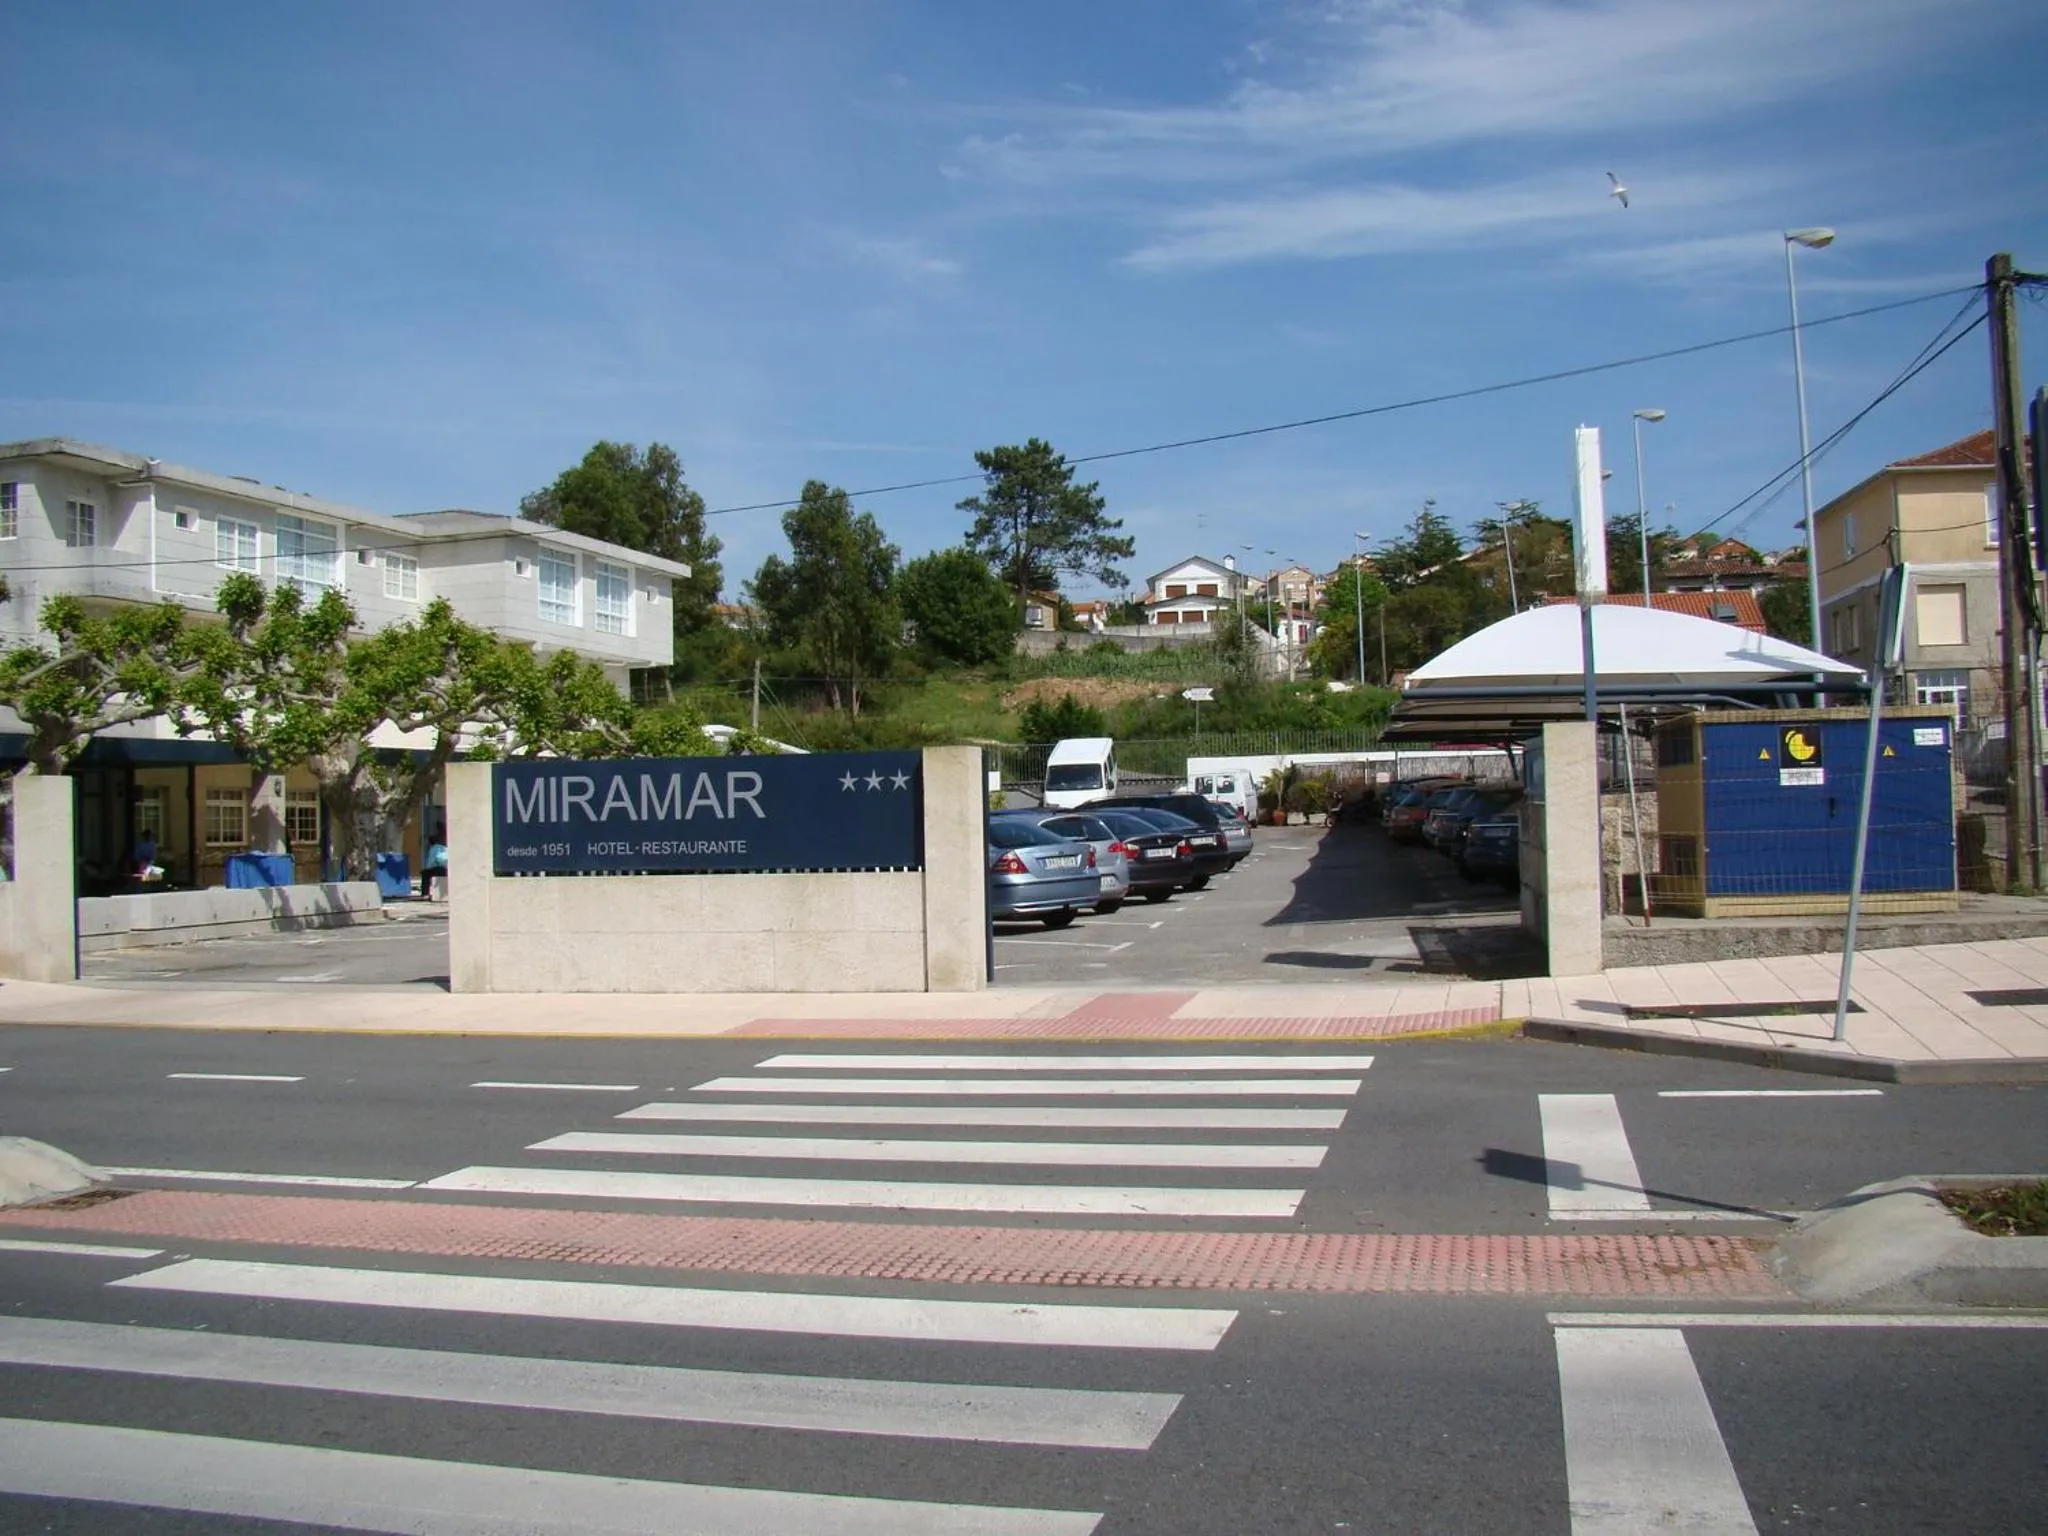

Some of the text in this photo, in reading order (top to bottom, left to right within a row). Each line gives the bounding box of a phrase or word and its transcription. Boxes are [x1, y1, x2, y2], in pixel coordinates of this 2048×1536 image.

[505, 770, 767, 824] MIRAMAR
[506, 844, 538, 857] desde
[541, 842, 571, 856] 1951
